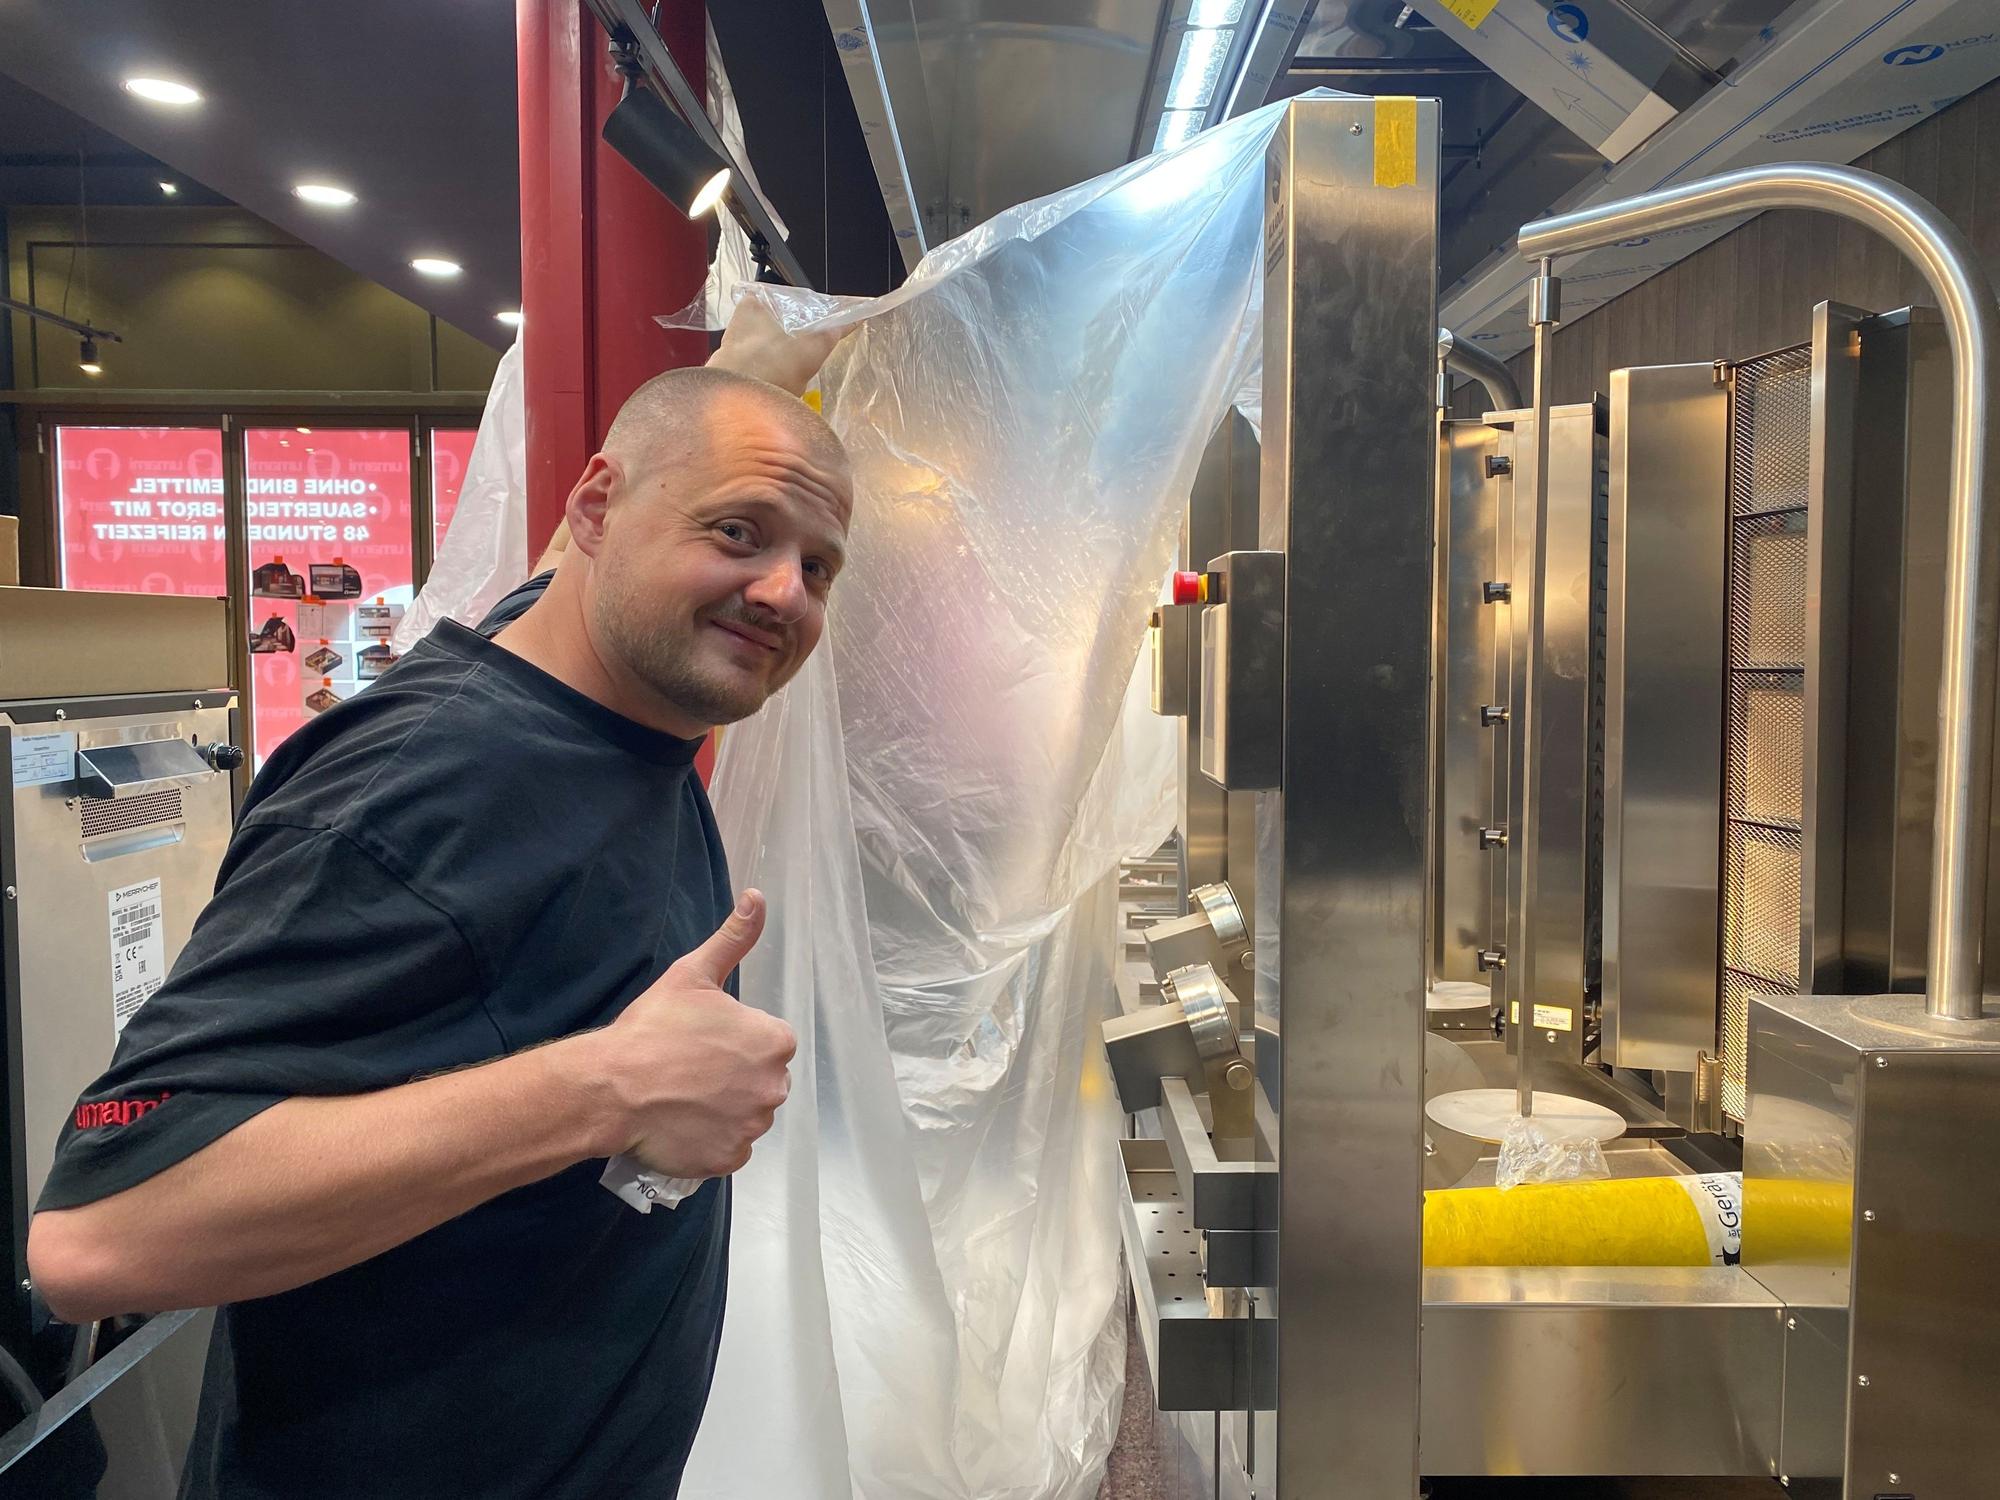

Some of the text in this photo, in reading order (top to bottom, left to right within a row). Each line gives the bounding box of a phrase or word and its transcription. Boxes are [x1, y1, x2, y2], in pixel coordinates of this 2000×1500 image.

[1844, 109, 1892, 123] LASER
[1772, 109, 1922, 145] The Novacel Solution
[1804, 119, 1839, 131] Fiber
[122, 881, 159, 898] MERRYCHEF
[1700, 1178, 1739, 1228] Gerät
